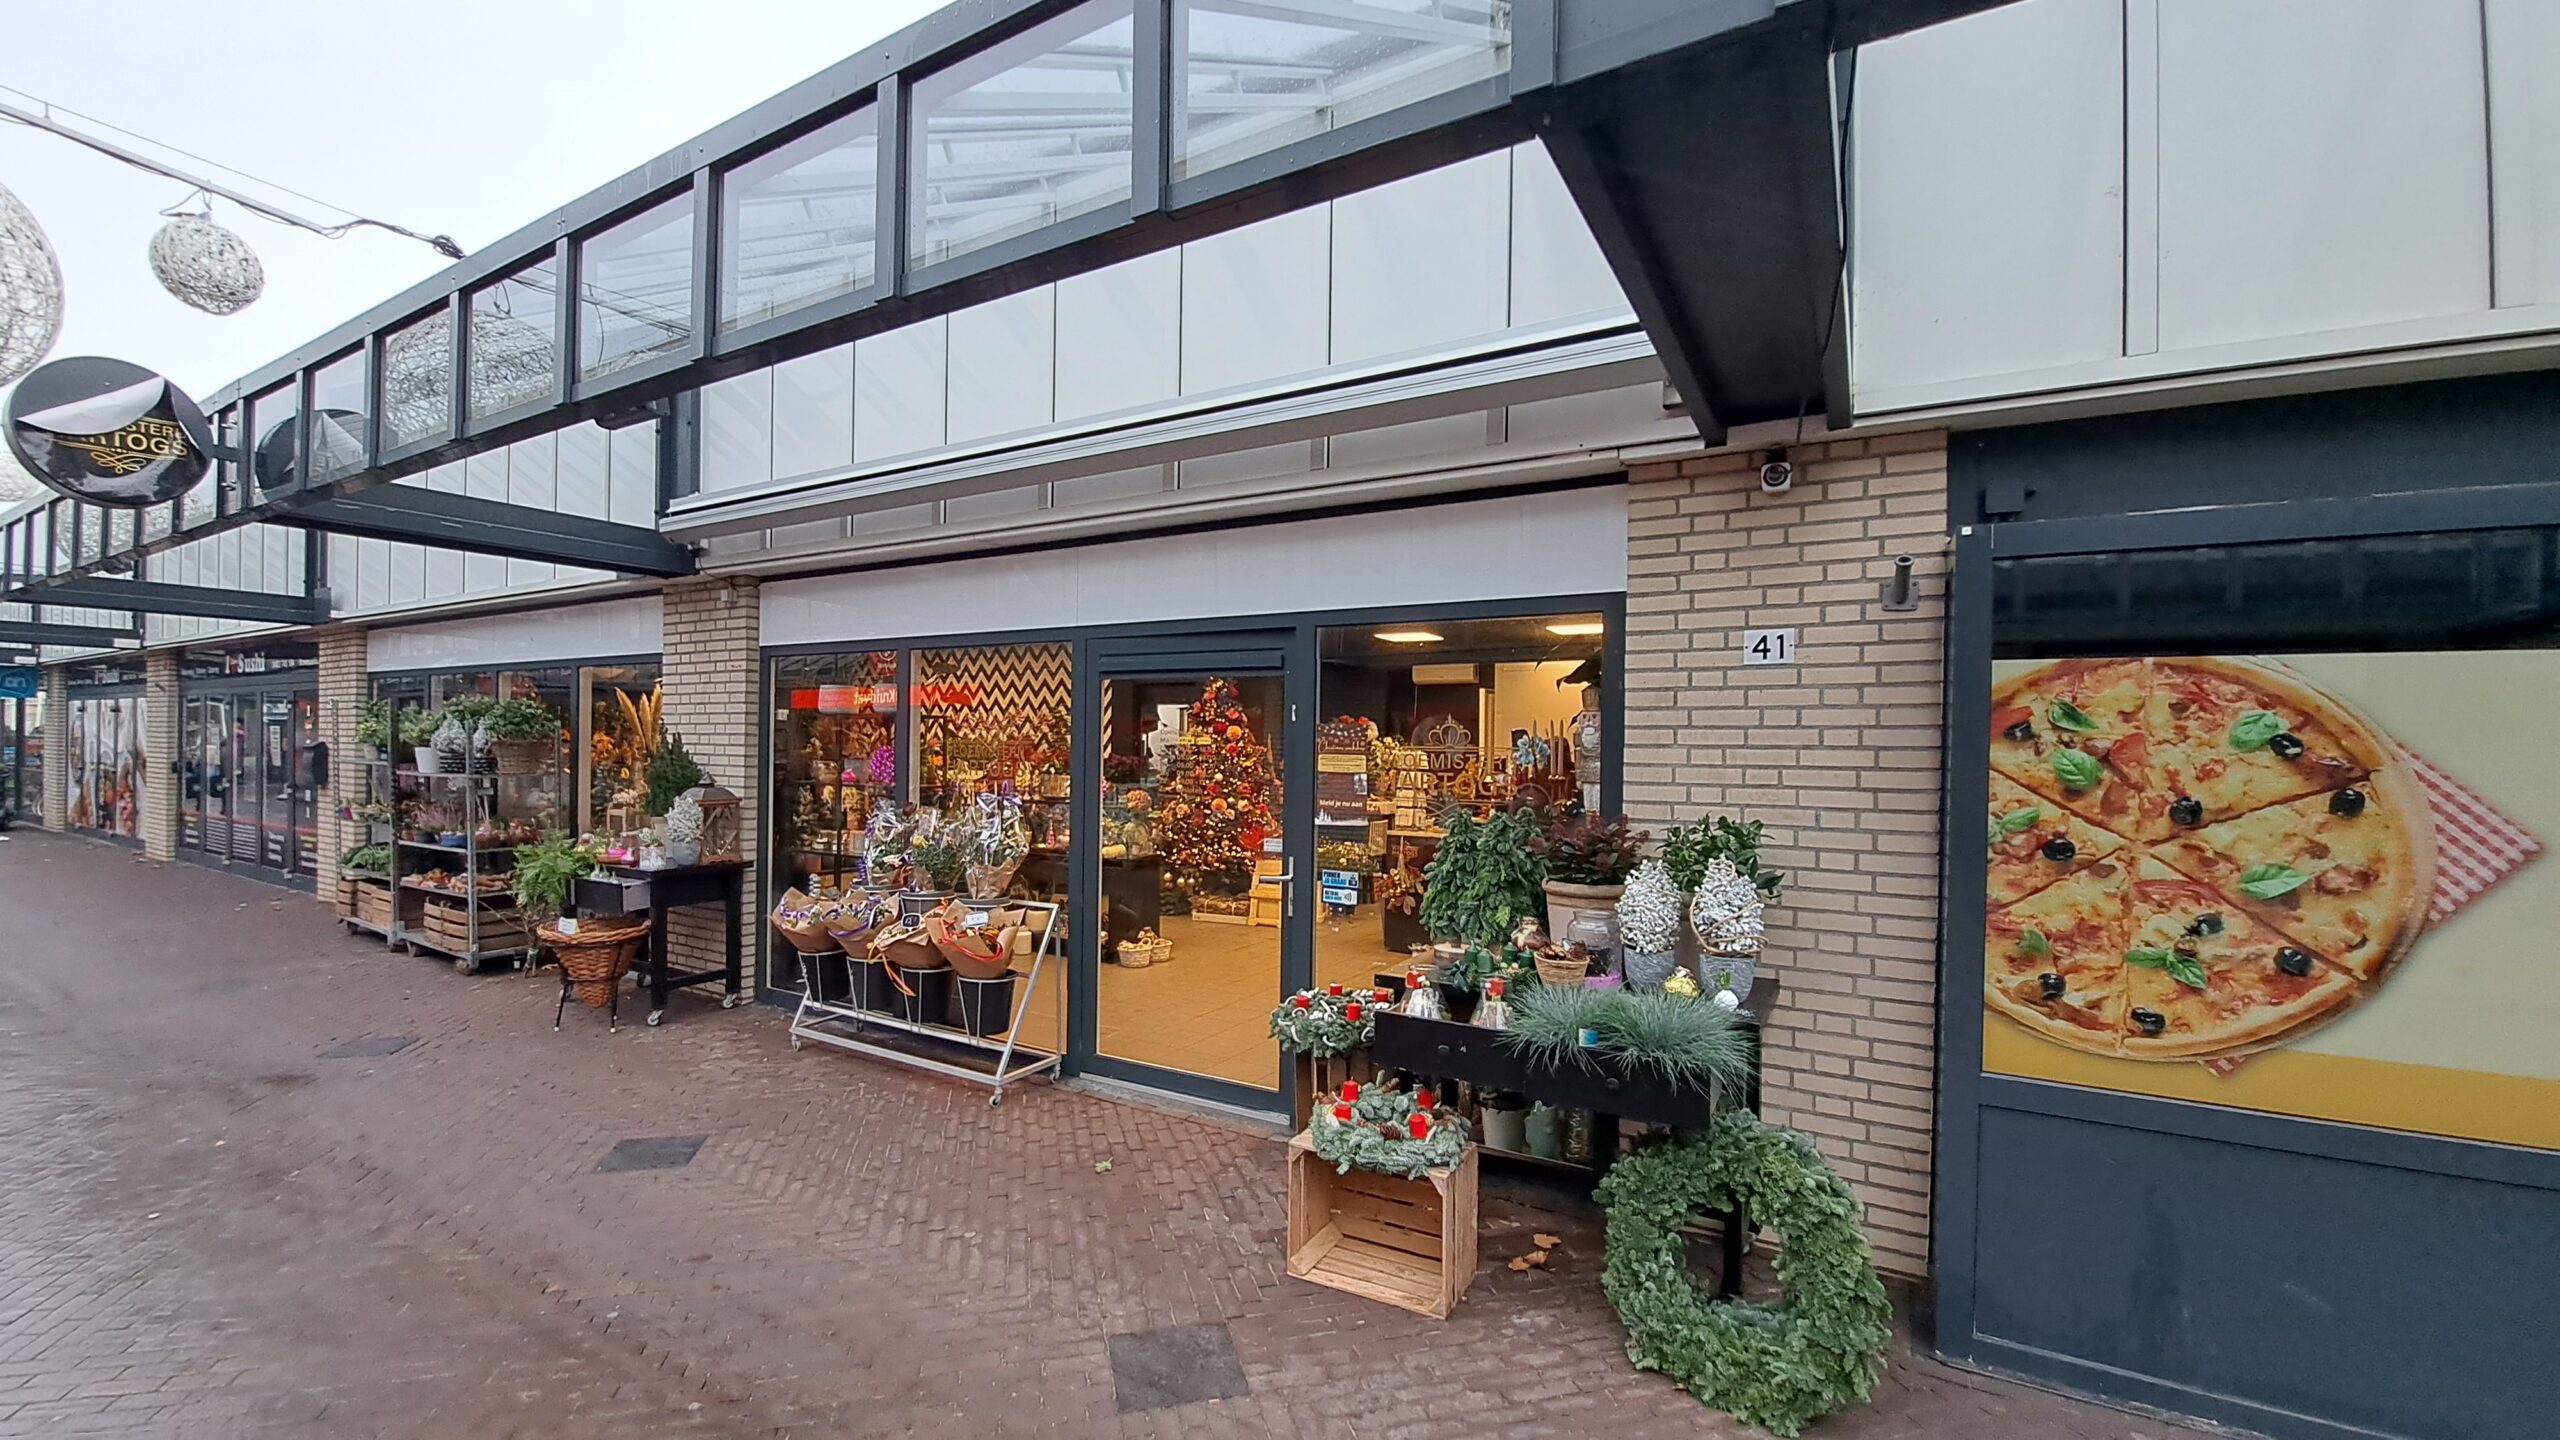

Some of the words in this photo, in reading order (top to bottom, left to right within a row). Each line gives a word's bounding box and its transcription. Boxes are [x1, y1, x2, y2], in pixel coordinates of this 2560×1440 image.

[1752, 633, 1784, 660] 41
[237, 651, 266, 673] Sushi
[1320, 799, 1334, 807] Meld
[1335, 800, 1341, 808] je
